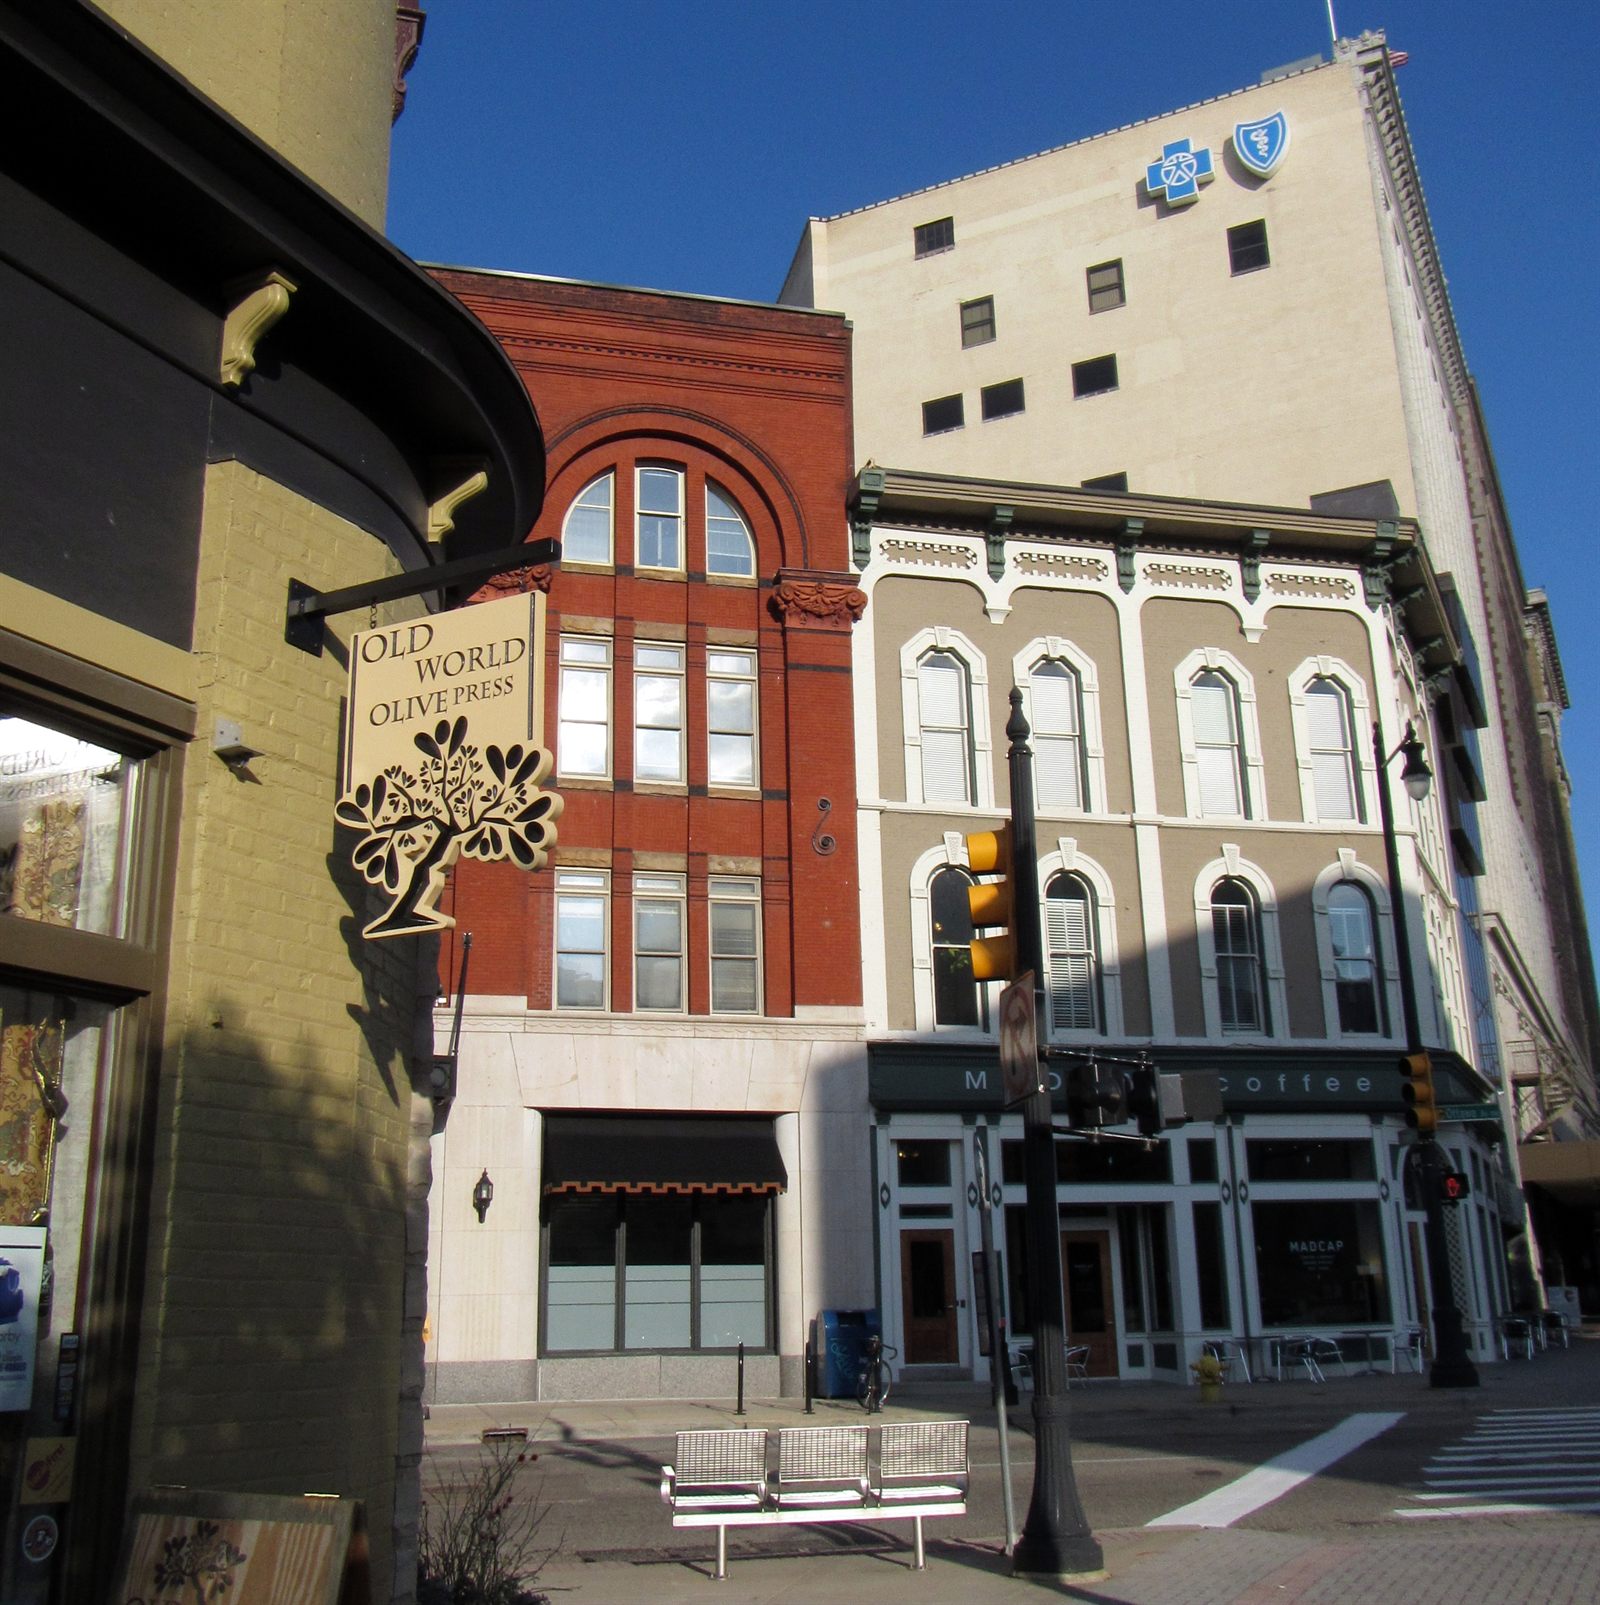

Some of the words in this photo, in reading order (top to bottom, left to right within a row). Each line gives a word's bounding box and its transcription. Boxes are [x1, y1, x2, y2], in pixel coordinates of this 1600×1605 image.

[361, 623, 434, 663] OLD
[414, 638, 526, 684] WORLD
[369, 689, 448, 726] OLIVE
[452, 675, 514, 705] PRESS
[1289, 1240, 1344, 1252] MADCAP
